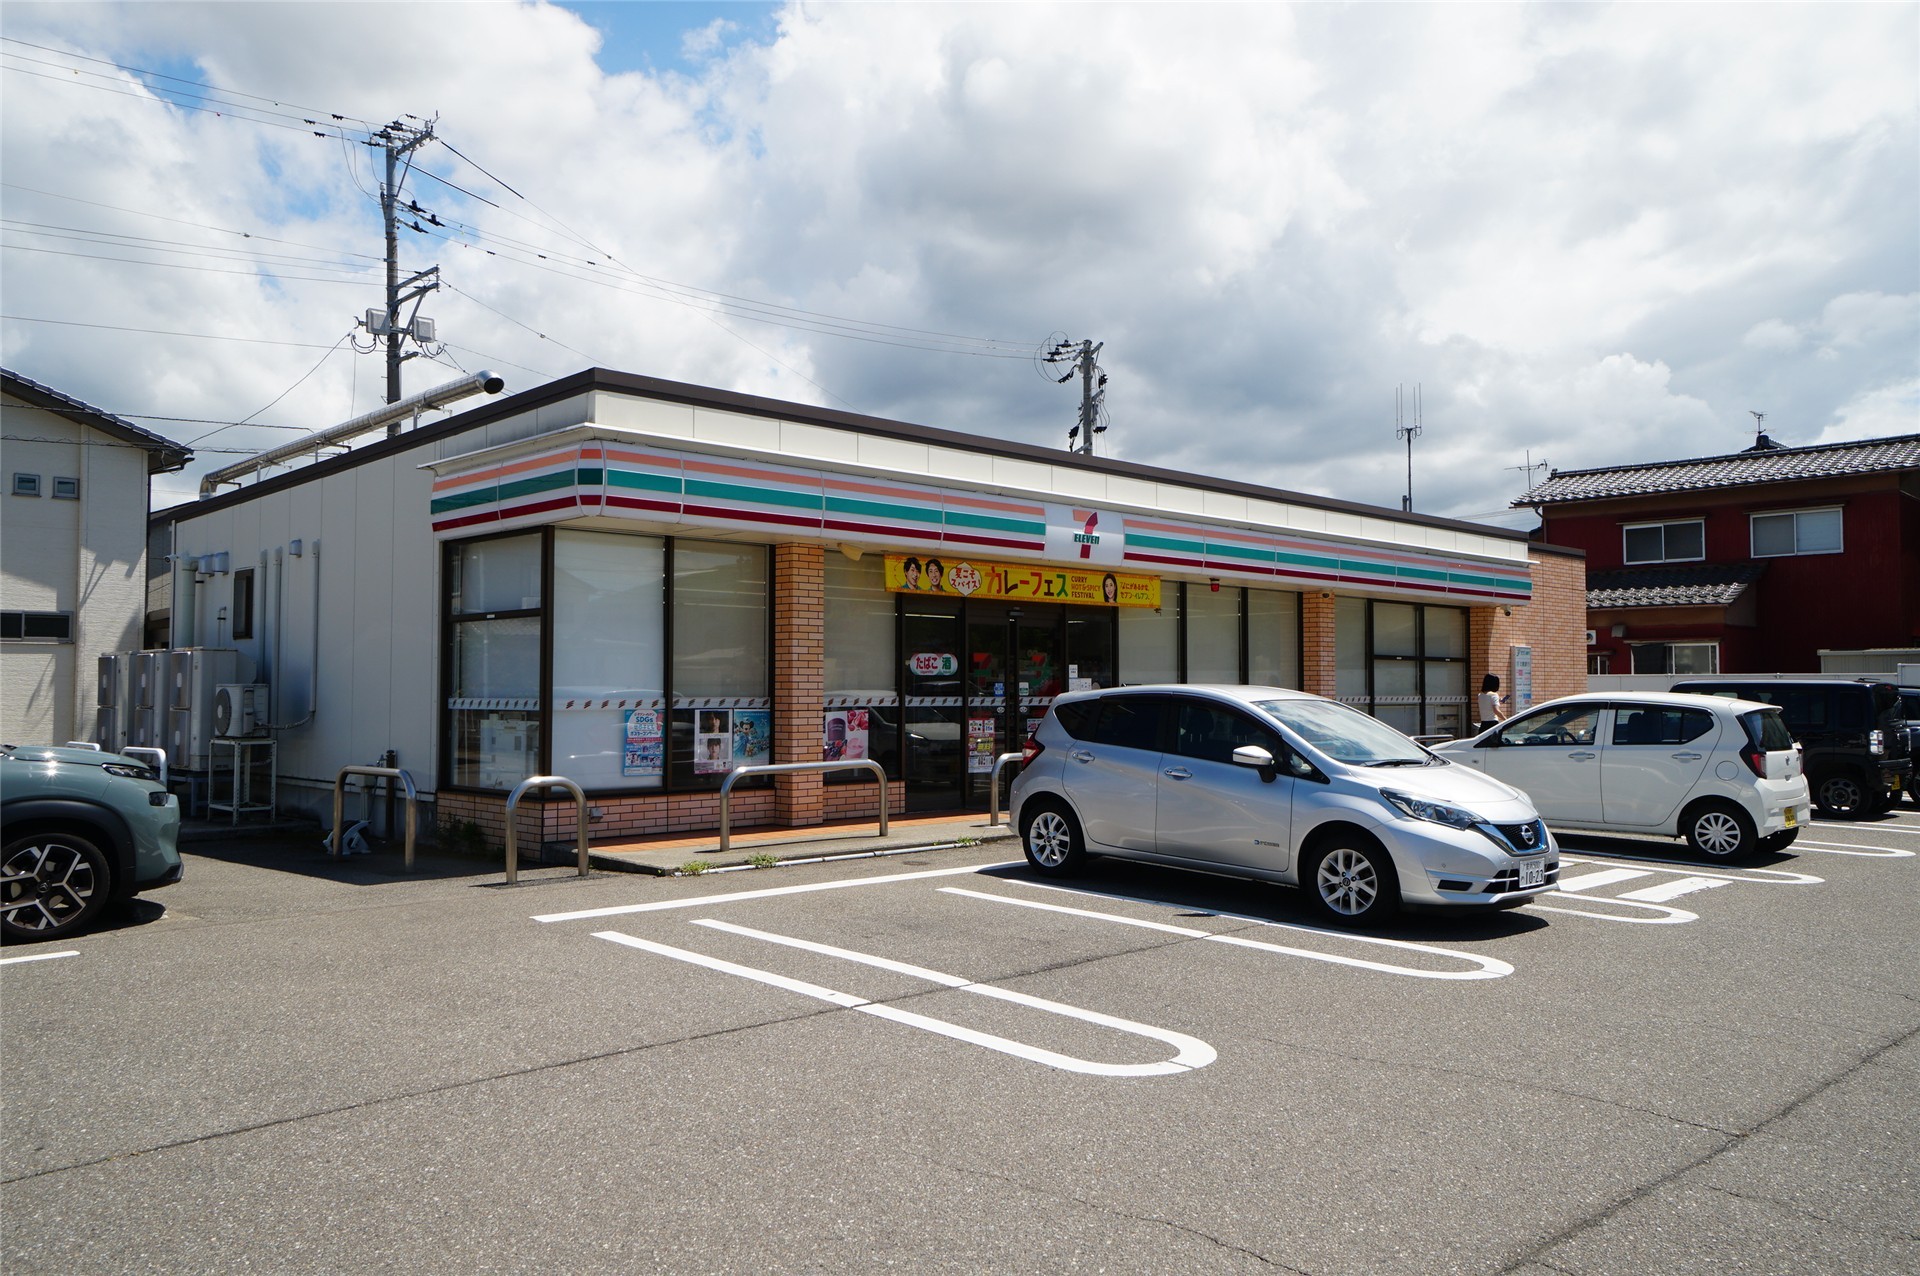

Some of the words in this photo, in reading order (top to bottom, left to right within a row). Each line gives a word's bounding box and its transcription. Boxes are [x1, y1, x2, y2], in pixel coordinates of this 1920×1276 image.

[1072, 510, 1098, 559] 7
[955, 566, 976, 580] 夏こそ
[1071, 575, 1088, 583] CURRY
[985, 566, 1069, 598] カレーフェス
[1071, 591, 1095, 600] FESTIVAL
[916, 656, 938, 669] たばこ
[942, 657, 951, 670] 酒
[1526, 869, 1543, 884] 10-23
